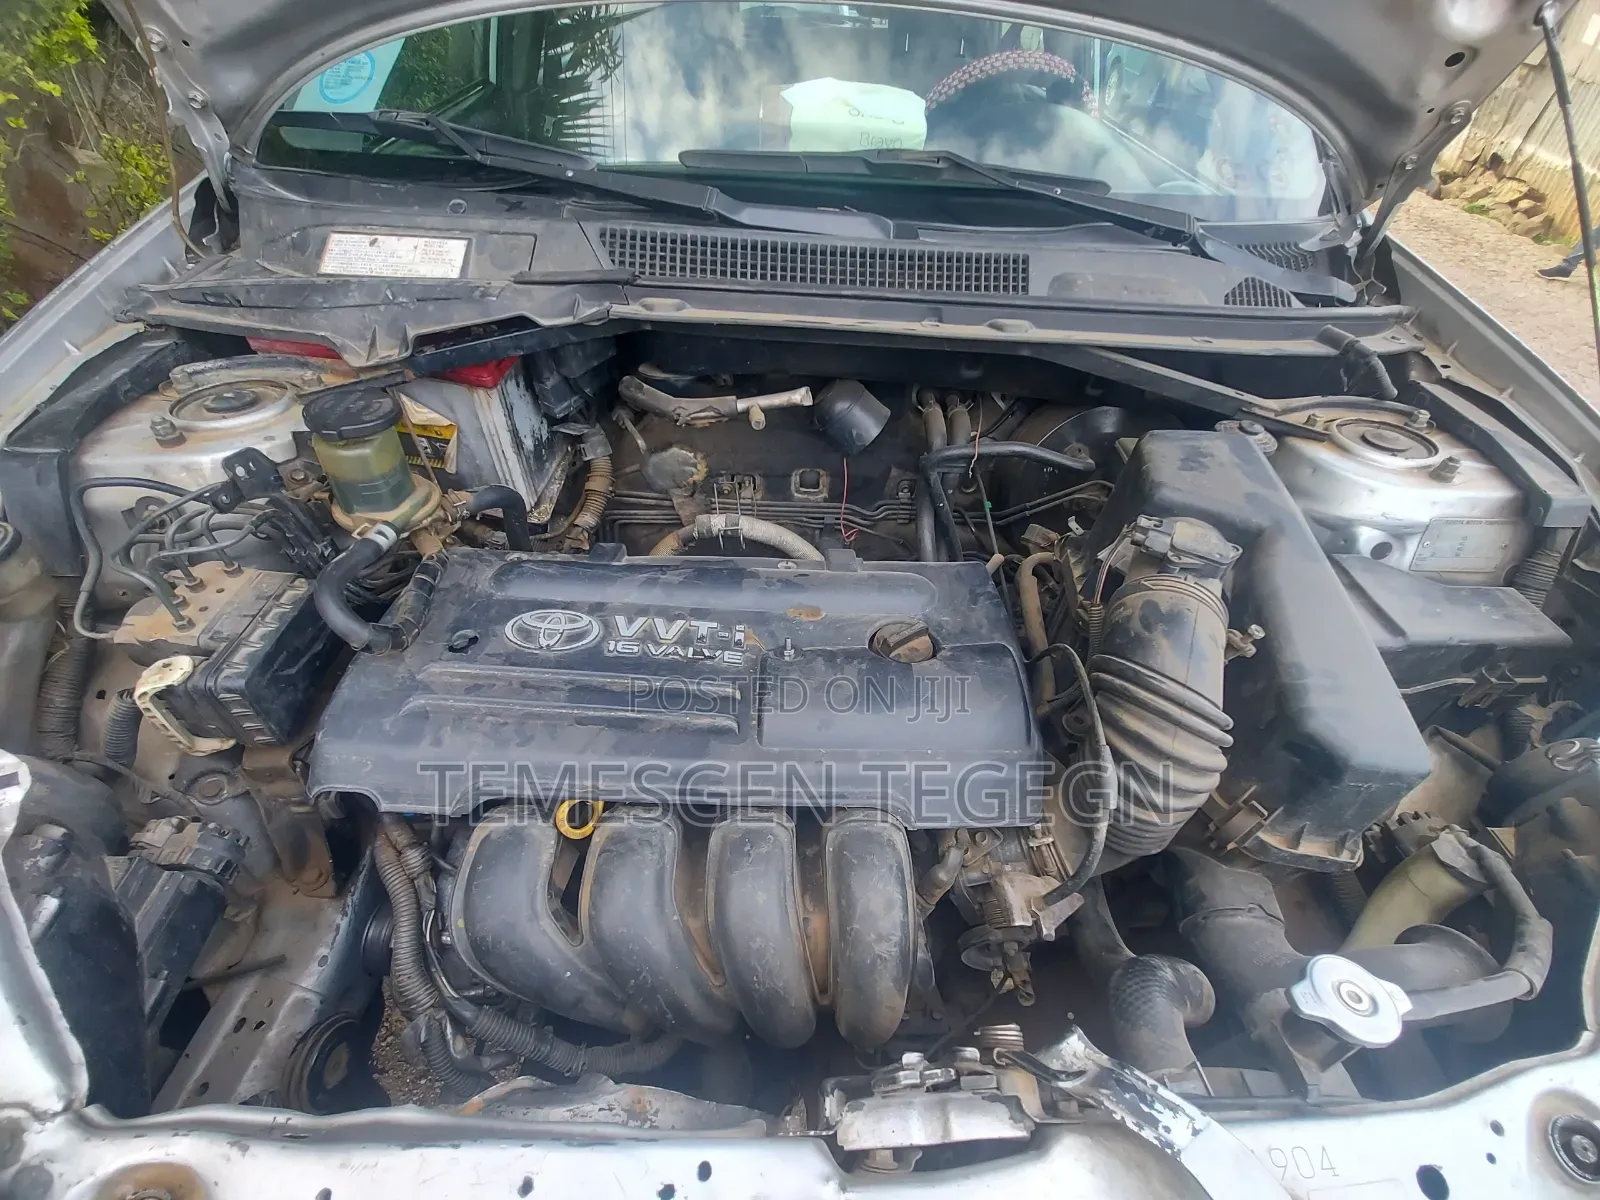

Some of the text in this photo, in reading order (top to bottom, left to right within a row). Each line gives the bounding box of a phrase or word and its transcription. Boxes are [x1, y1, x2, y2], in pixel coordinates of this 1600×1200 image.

[605, 639, 745, 667] 16 VALVE
[1268, 1145, 1340, 1182] 904
